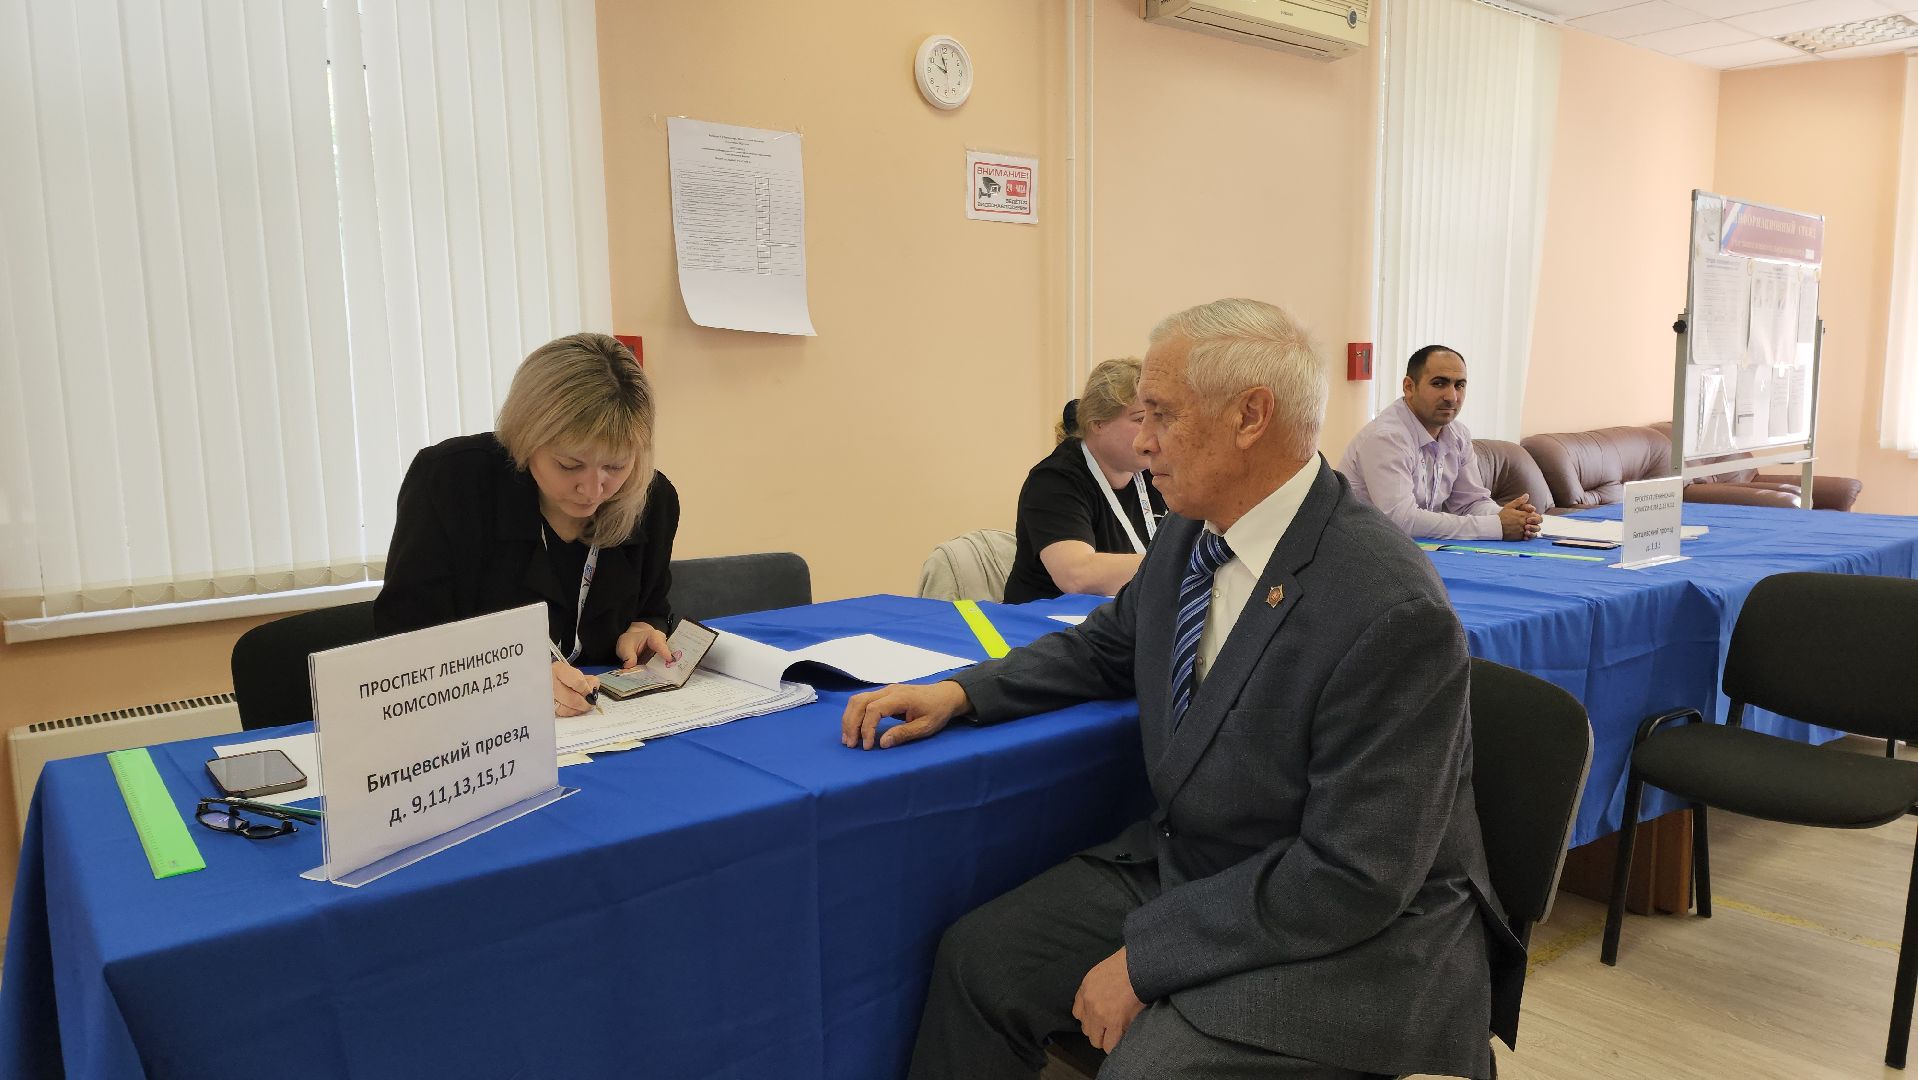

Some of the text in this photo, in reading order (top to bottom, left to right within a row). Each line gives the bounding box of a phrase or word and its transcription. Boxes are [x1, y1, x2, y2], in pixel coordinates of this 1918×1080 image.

[977, 167, 1029, 179] ВНИМАНИЕ!
[359, 643, 524, 699] ПРОСПЕКТ ЛЕНИНСКОГО
[383, 671, 510, 720] КОМСОМОЛА Д.25
[367, 725, 530, 793] Битцевский проезд
[390, 760, 516, 827] д. 9,11,13,15,17
